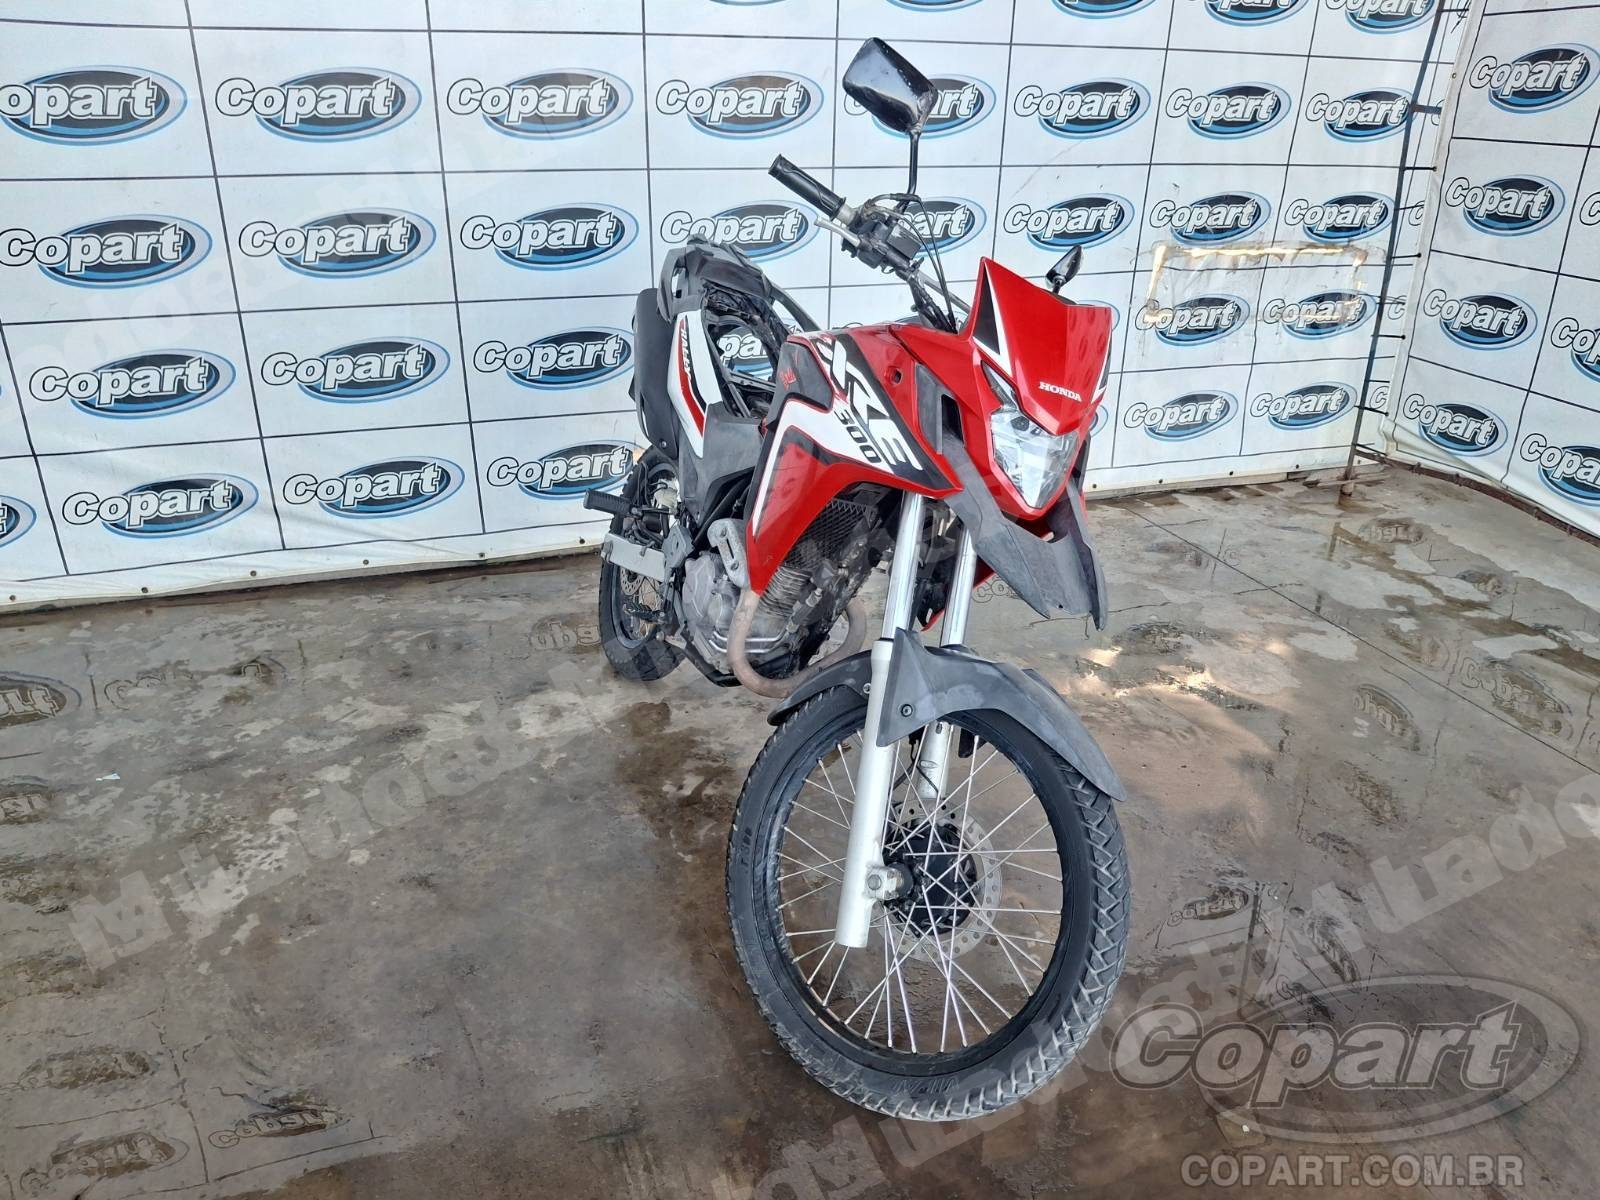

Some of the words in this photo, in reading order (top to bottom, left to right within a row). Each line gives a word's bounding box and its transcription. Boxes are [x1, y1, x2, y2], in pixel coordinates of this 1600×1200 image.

[1325, 0, 1425, 19] opart
[1469, 54, 1587, 99] Copart
[0, 77, 157, 127] opart
[215, 76, 396, 126] Copart
[447, 77, 608, 124] Copart
[656, 78, 804, 125] Copart
[1014, 84, 1136, 126] Copart
[1166, 88, 1278, 125] Copart
[1306, 93, 1412, 127] Copart
[1004, 202, 1124, 241] Copart
[1150, 198, 1257, 235] Copart
[1285, 199, 1382, 232] Copart
[1445, 177, 1550, 220] Copart
[0, 222, 184, 274] Copart
[239, 217, 411, 265] Copart
[460, 210, 616, 258] Copart
[1135, 299, 1238, 335] Copart
[1423, 289, 1523, 337] Copart
[261, 344, 427, 392] Copart
[474, 334, 622, 380] Copart
[29, 357, 208, 407] Copart
[1038, 381, 1083, 402] HONDA
[1250, 386, 1346, 424] Copart
[833, 408, 882, 464] 300
[1124, 397, 1226, 432] Copart
[1403, 393, 1495, 447] Copart
[487, 446, 631, 492] Copart
[1520, 433, 1600, 487] Copa
[62, 480, 233, 529] Copart
[283, 462, 442, 509] Copart
